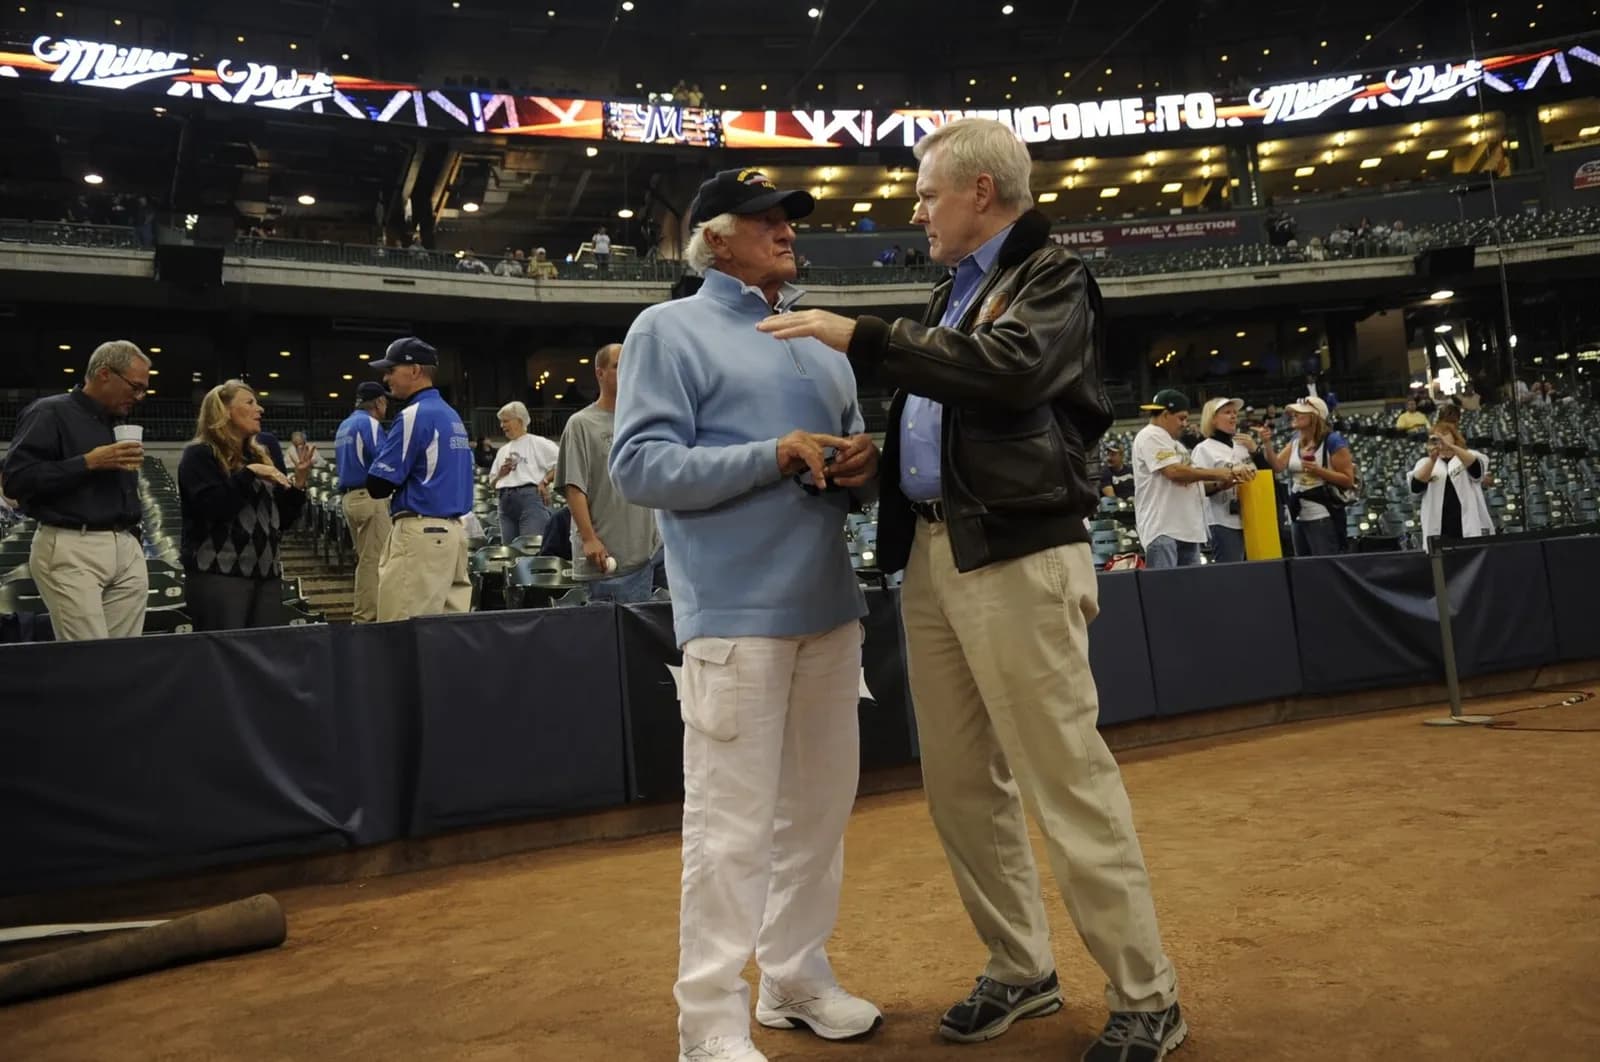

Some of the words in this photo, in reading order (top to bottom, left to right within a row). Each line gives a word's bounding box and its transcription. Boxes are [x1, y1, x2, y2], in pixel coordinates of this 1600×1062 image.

[33, 36, 190, 86] Miller
[217, 59, 334, 107] Park
[1248, 75, 1365, 124] Miller
[1386, 60, 1484, 106] Park
[1049, 230, 1104, 245] OHL'S
[1121, 225, 1171, 237] FAMILY
[1175, 220, 1236, 233] SECTION
